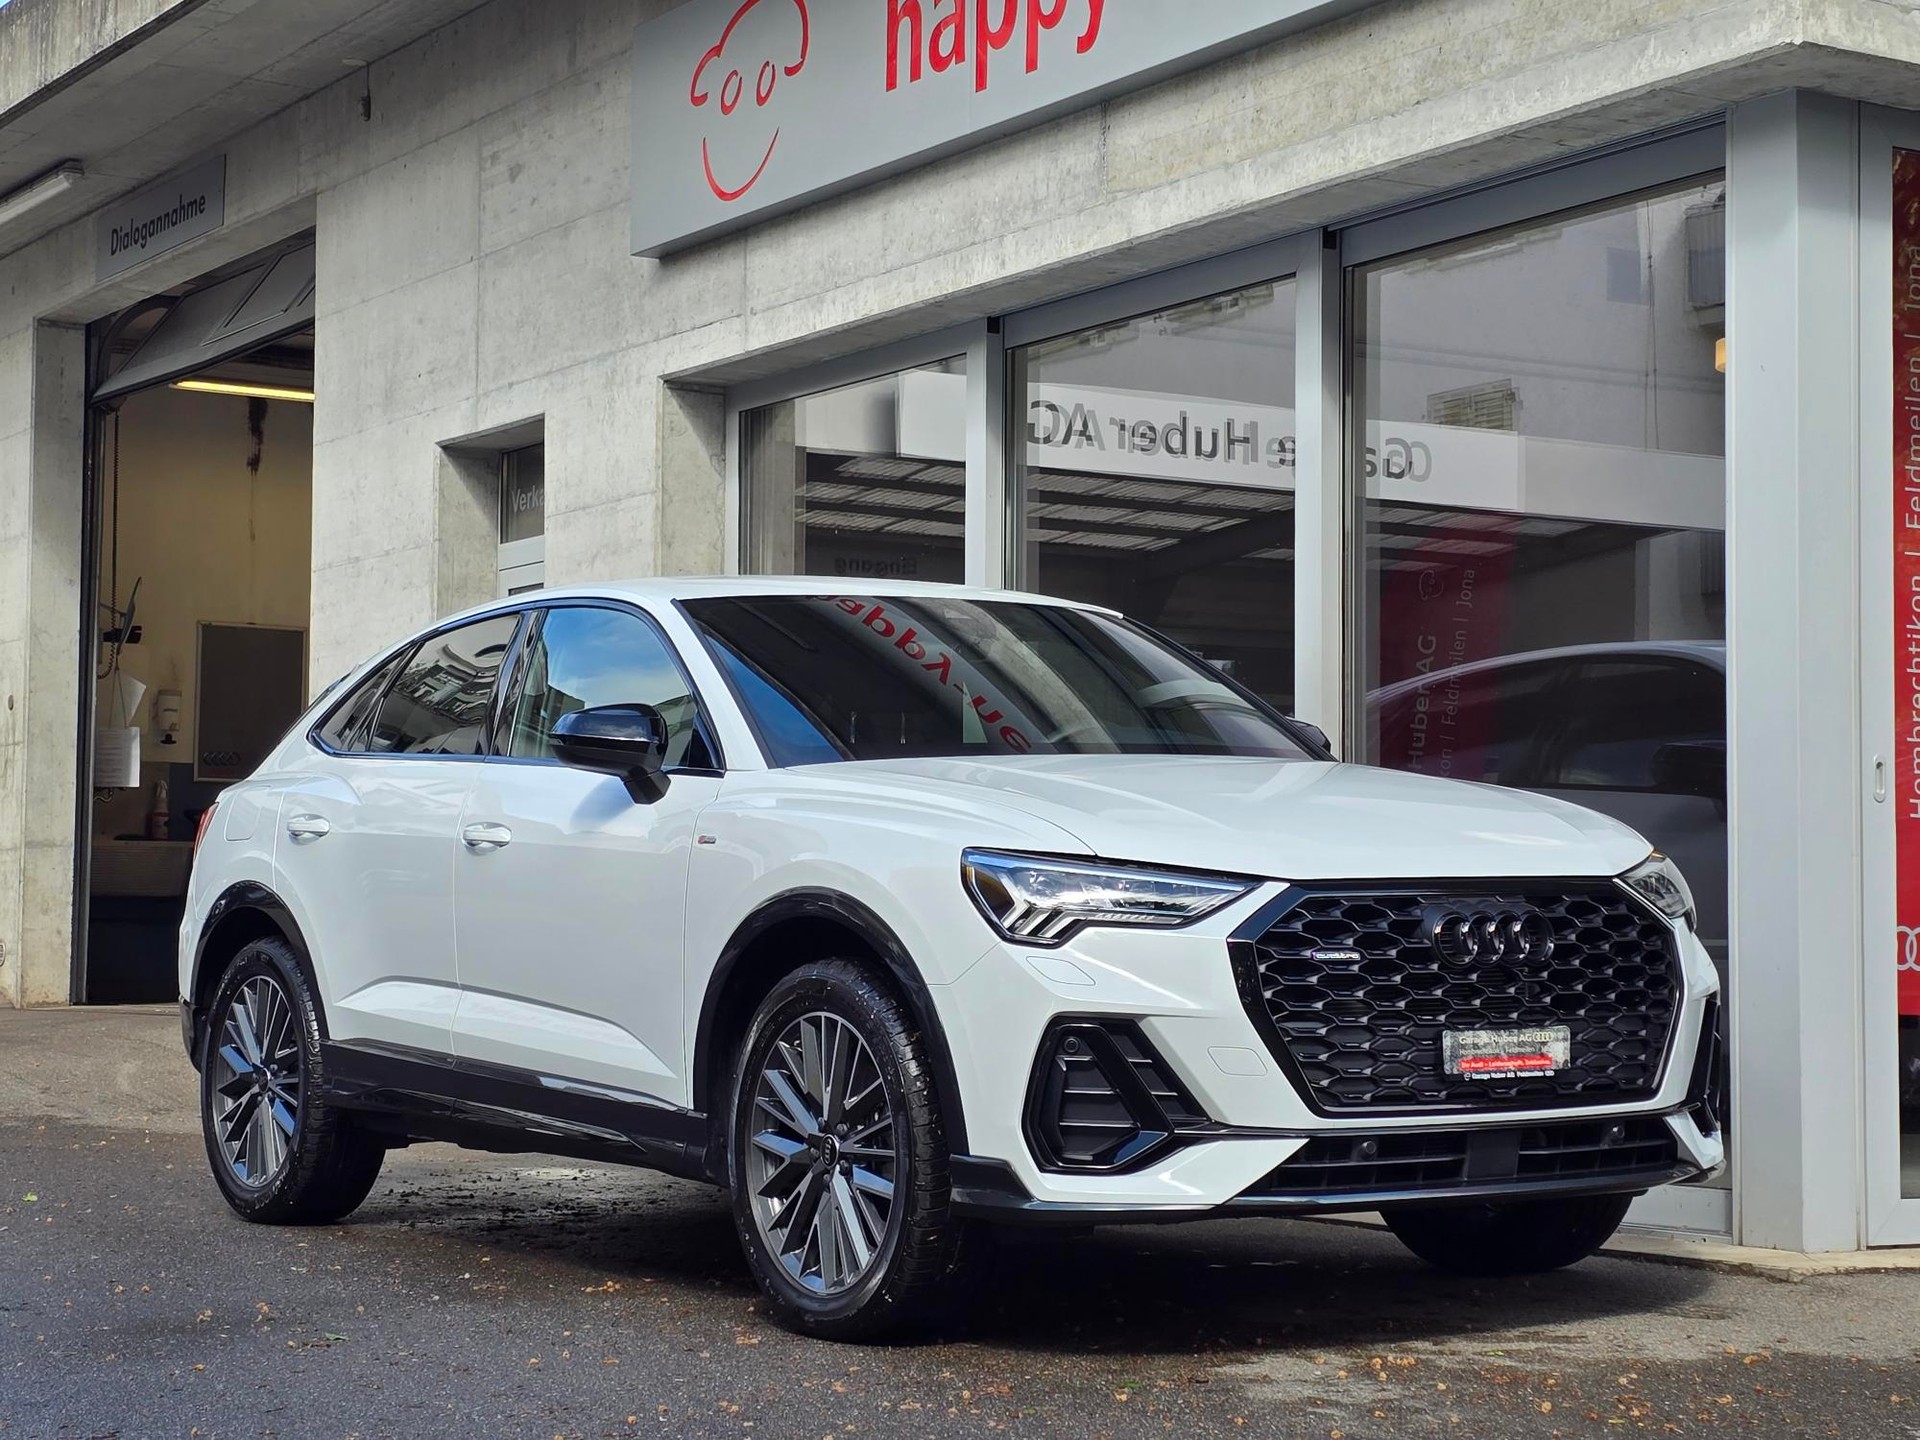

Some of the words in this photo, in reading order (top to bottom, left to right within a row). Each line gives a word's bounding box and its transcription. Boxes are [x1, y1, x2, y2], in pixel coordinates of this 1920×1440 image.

[110, 193, 206, 257] Dialogannahme
[1455, 568, 1476, 608] Jona
[1416, 634, 1437, 673] AG
[1519, 1034, 1532, 1042] AG
